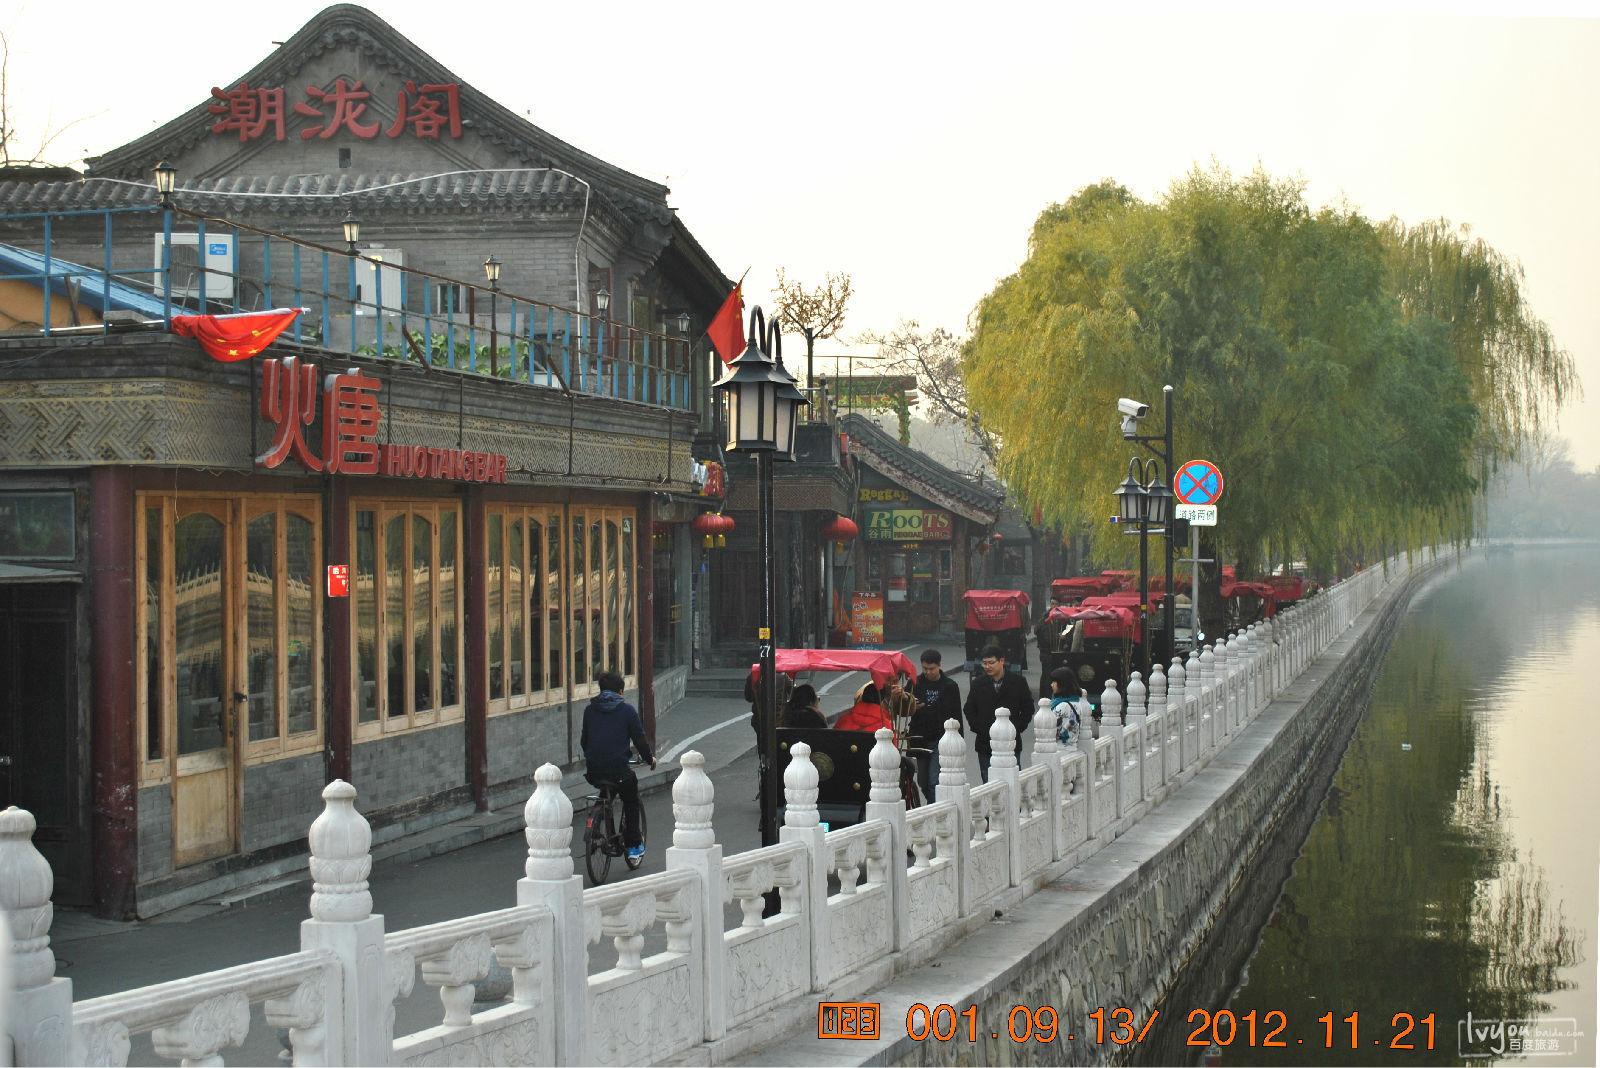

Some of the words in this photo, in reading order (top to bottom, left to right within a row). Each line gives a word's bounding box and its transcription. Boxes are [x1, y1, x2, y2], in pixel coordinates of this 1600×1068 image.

[208, 79, 463, 142] 潮泷阁
[1179, 509, 1215, 521] 道路两侧
[868, 528, 892, 539] 谷雨
